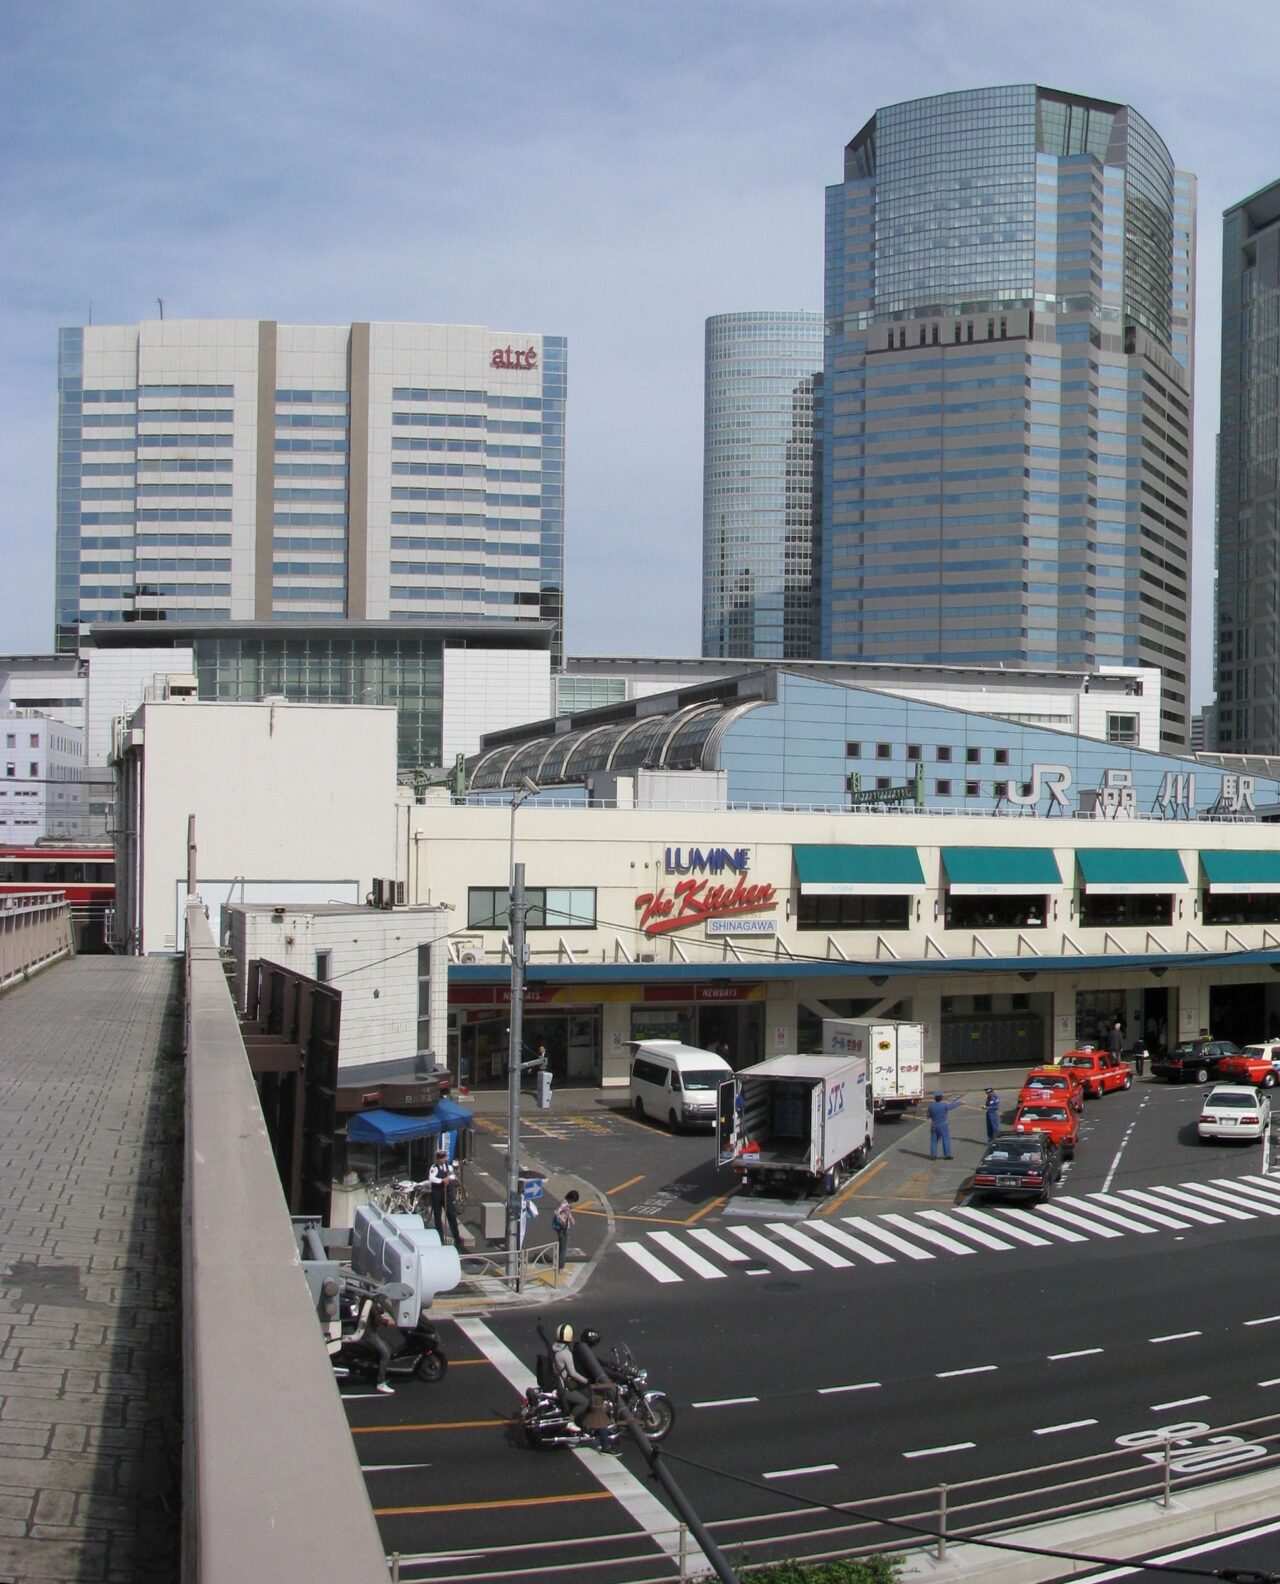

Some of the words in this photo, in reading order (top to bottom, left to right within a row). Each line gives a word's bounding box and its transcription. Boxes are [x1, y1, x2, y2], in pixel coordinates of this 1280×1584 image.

[491, 344, 537, 369] atré
[1007, 763, 1072, 805] JR
[1103, 768, 1256, 812] 品川駅
[665, 847, 751, 876] LUMINE
[634, 887, 675, 928] The
[673, 873, 777, 917] Kitchen
[712, 921, 774, 931] SHINAGAWA
